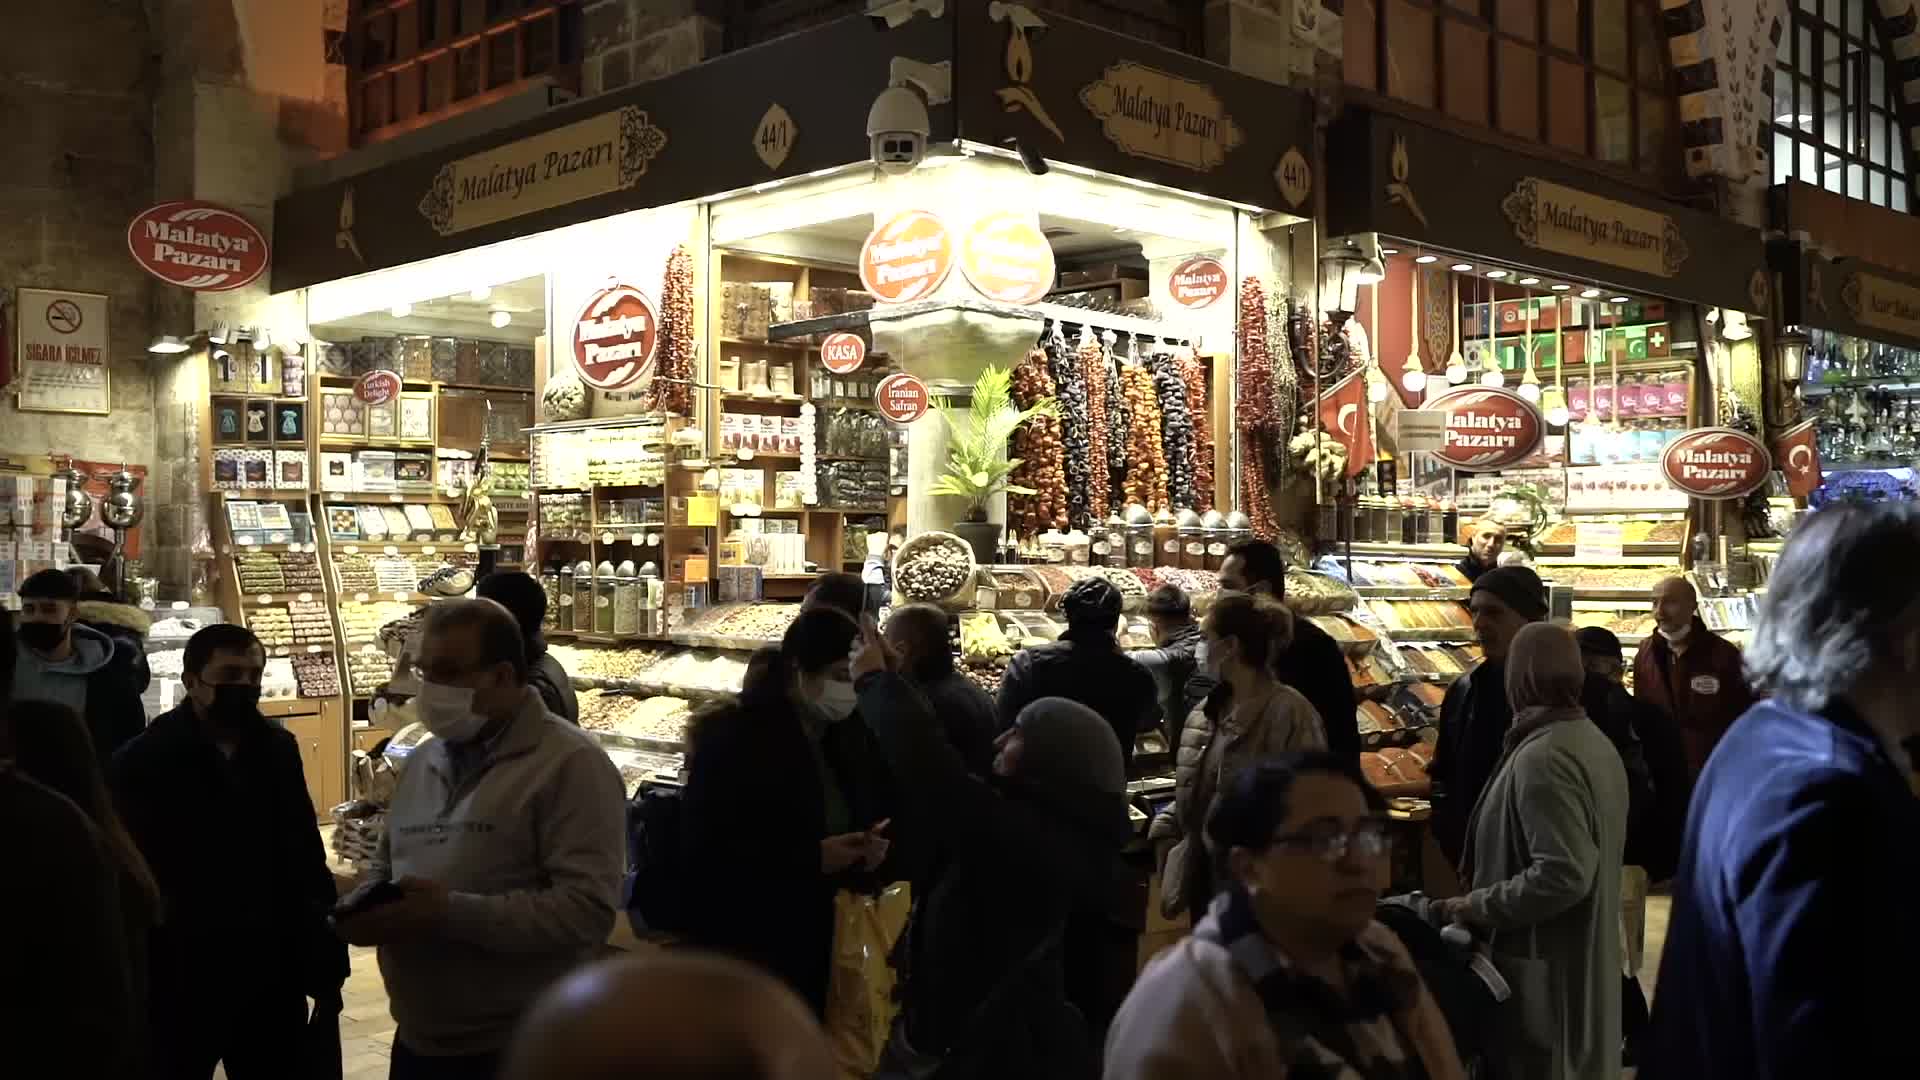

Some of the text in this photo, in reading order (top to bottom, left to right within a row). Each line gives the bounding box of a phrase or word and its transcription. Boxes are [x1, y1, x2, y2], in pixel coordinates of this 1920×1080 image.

[1113, 84, 1171, 138] Malatya
[761, 119, 786, 152] 44/1
[458, 141, 613, 203] Malatya Pazarı
[1541, 201, 1608, 246] Malatya
[144, 220, 249, 253] Malatya
[153, 242, 241, 272] Pazarı
[1174, 273, 1221, 286] Malatya
[827, 344, 858, 361] KASA
[363, 379, 391, 390] Turkish
[363, 388, 390, 399] Delight
[887, 384, 919, 399] Iranian
[889, 399, 918, 411] Safran
[1444, 430, 1516, 448] Pazarı
[1676, 448, 1753, 468] Malatya
[1682, 464, 1748, 479] Pazarı
